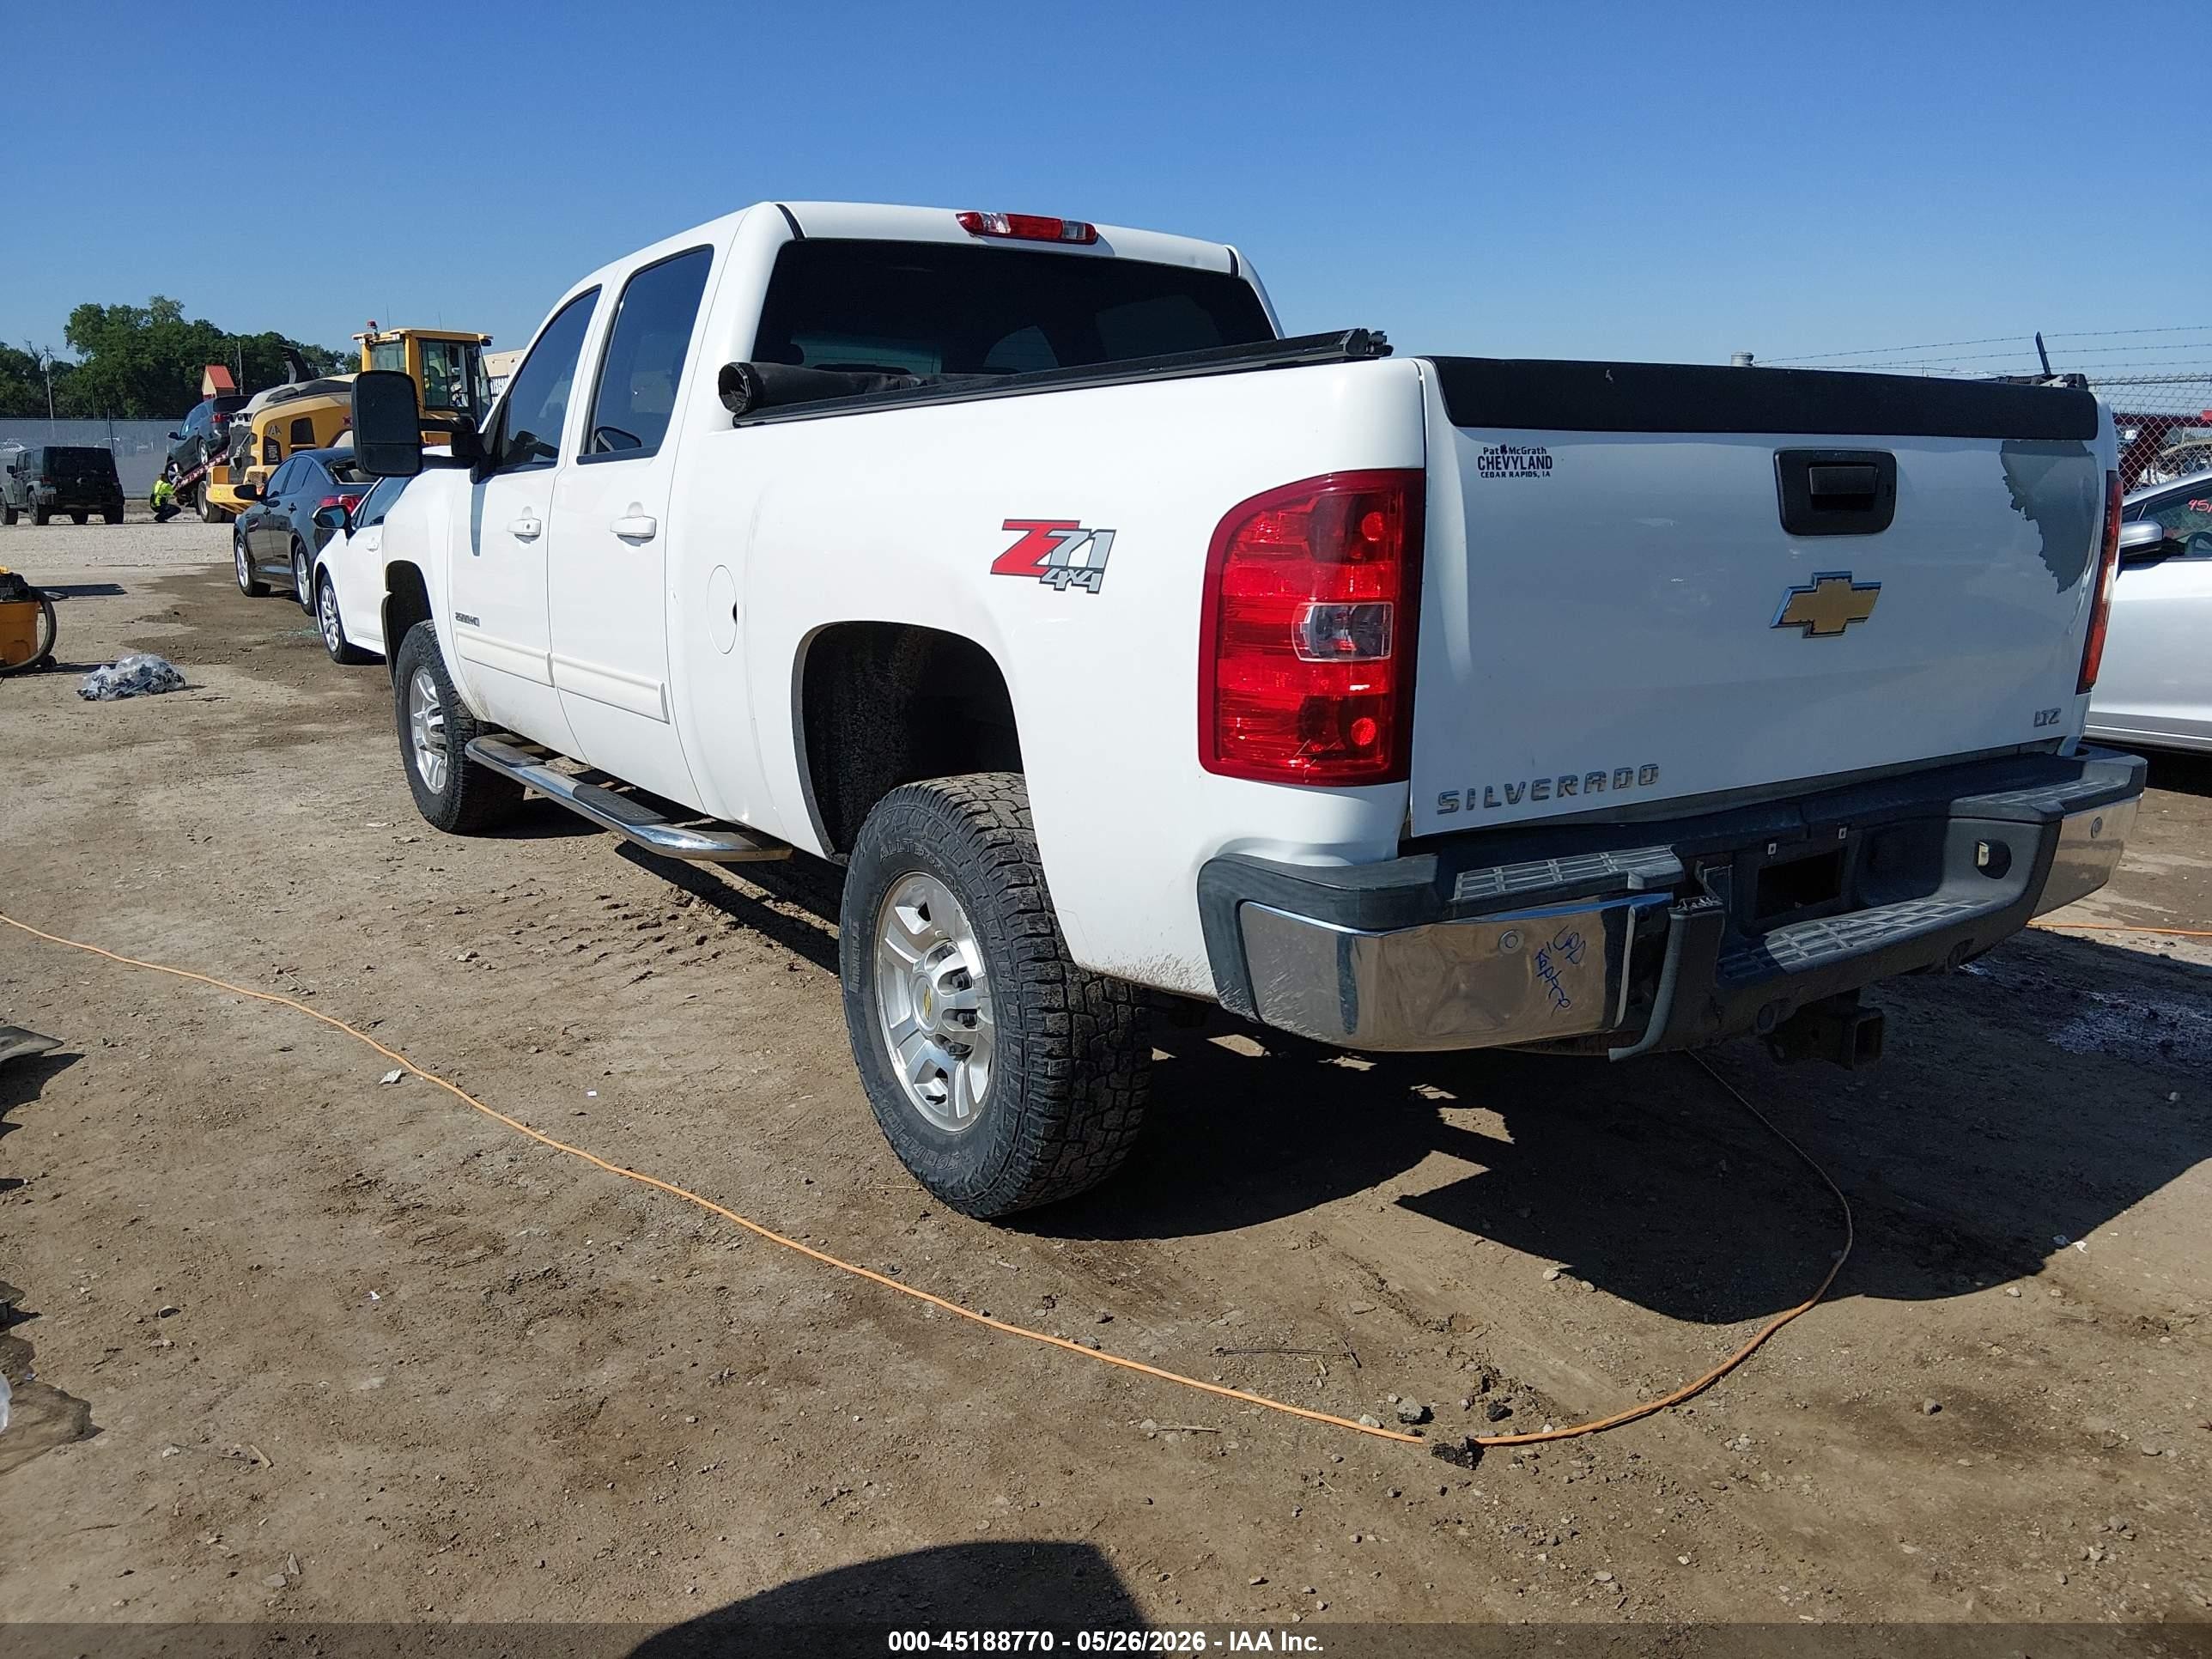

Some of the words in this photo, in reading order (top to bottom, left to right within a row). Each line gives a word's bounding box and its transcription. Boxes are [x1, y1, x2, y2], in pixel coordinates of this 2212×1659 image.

[1483, 447, 1500, 455] Pat
[1508, 447, 1547, 455] McGrath
[1477, 455, 1553, 471] CHEVYLAND
[990, 519, 1117, 578] Z71
[2033, 708, 2062, 728] LTZ
[1436, 763, 1660, 816] SILVERADO
